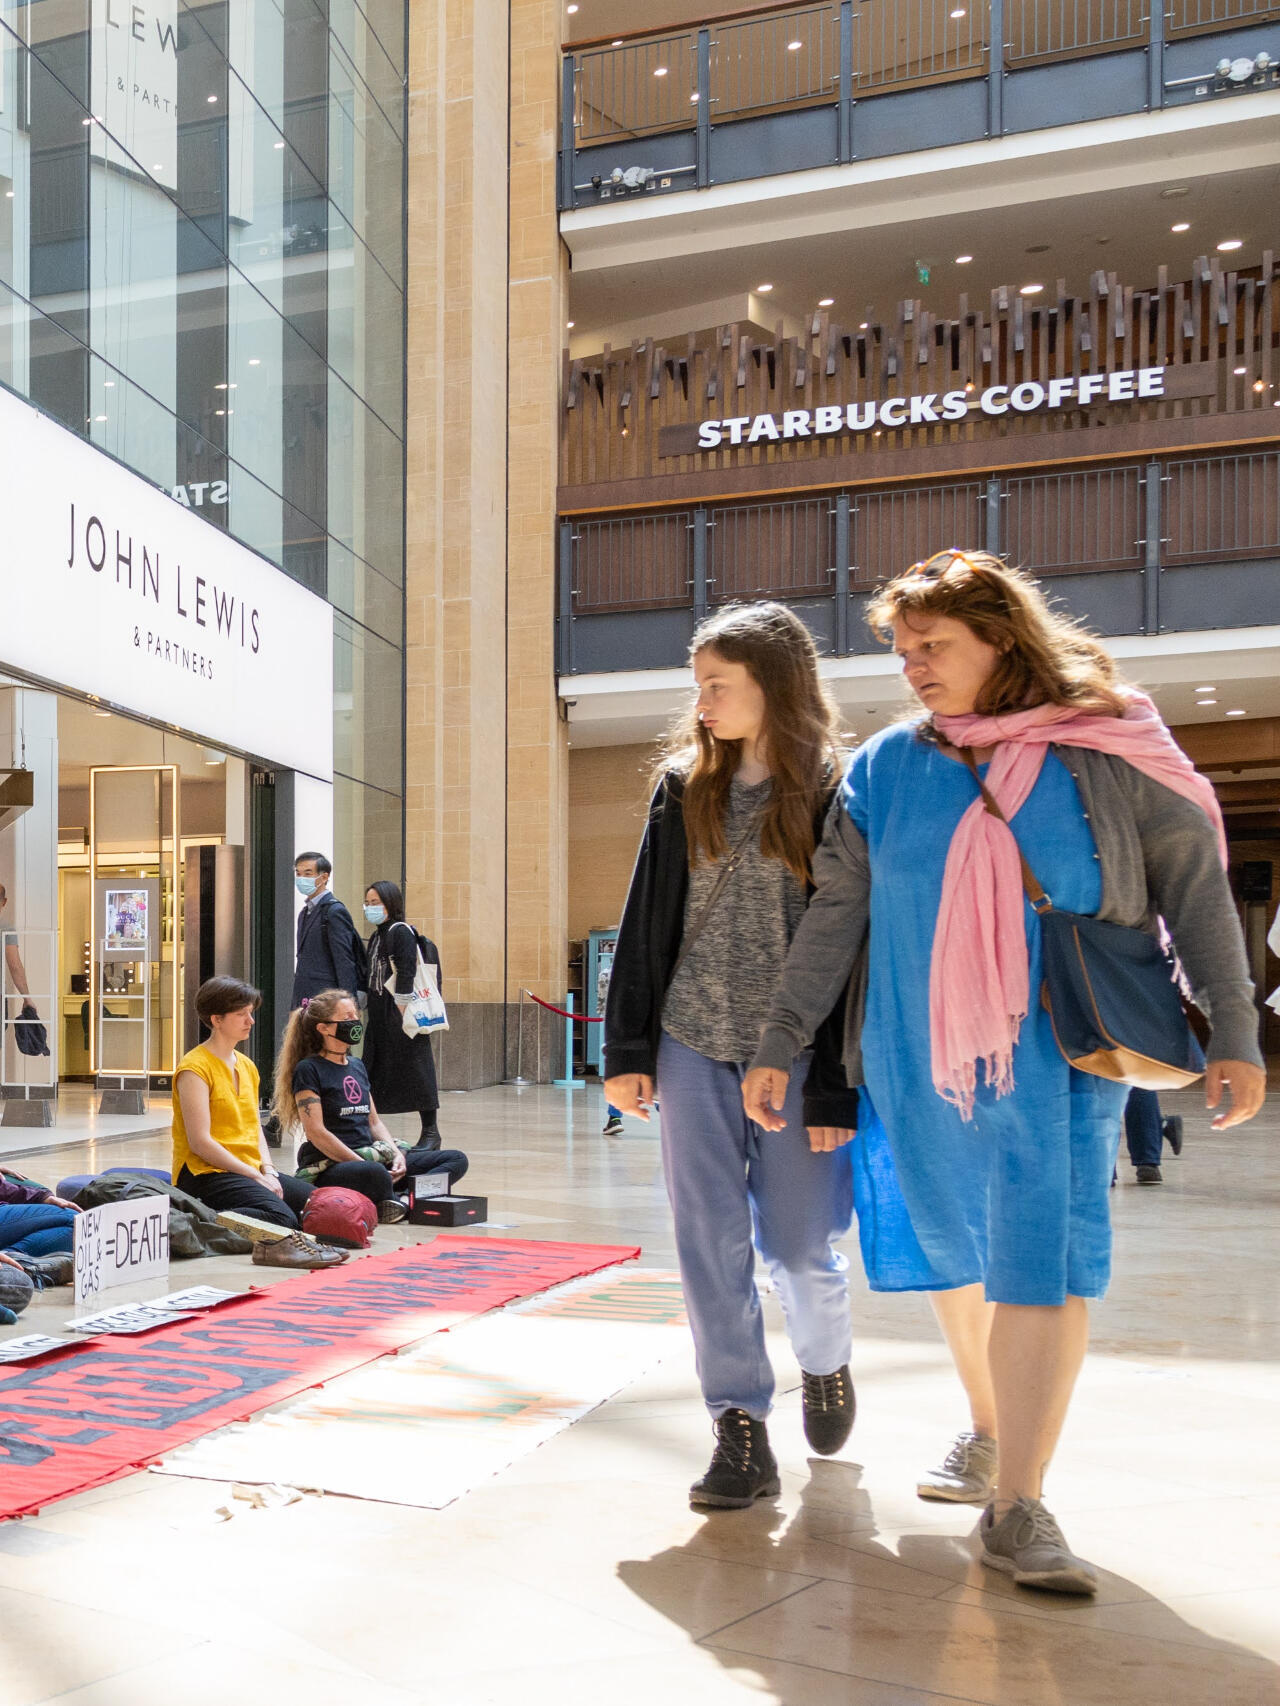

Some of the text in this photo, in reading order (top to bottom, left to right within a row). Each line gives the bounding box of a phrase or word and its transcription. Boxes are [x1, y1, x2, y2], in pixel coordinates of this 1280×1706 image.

[697, 366, 1165, 448] STARBUCKS COFFEE
[67, 503, 260, 654] JOHN LEWIS
[133, 625, 214, 680] & PARTNERS
[81, 1210, 102, 1239] NEW
[76, 1242, 93, 1274] OIL
[81, 1265, 100, 1299] GAS
